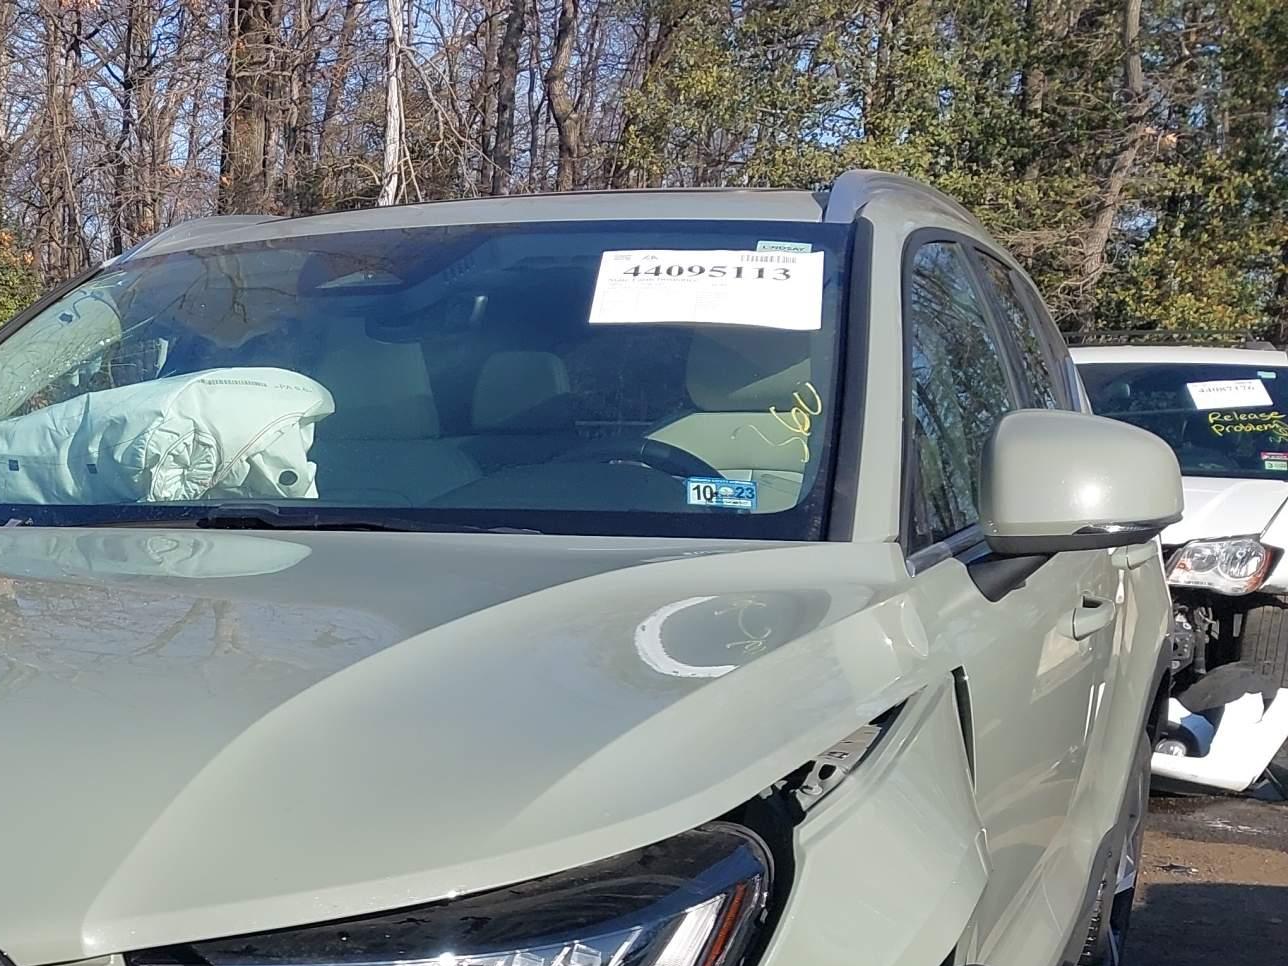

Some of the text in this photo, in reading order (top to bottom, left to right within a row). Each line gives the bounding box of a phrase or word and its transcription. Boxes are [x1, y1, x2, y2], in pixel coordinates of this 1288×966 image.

[623, 264, 792, 281] 44095113
[1208, 411, 1287, 423] Release
[692, 484, 755, 501] 10 23
